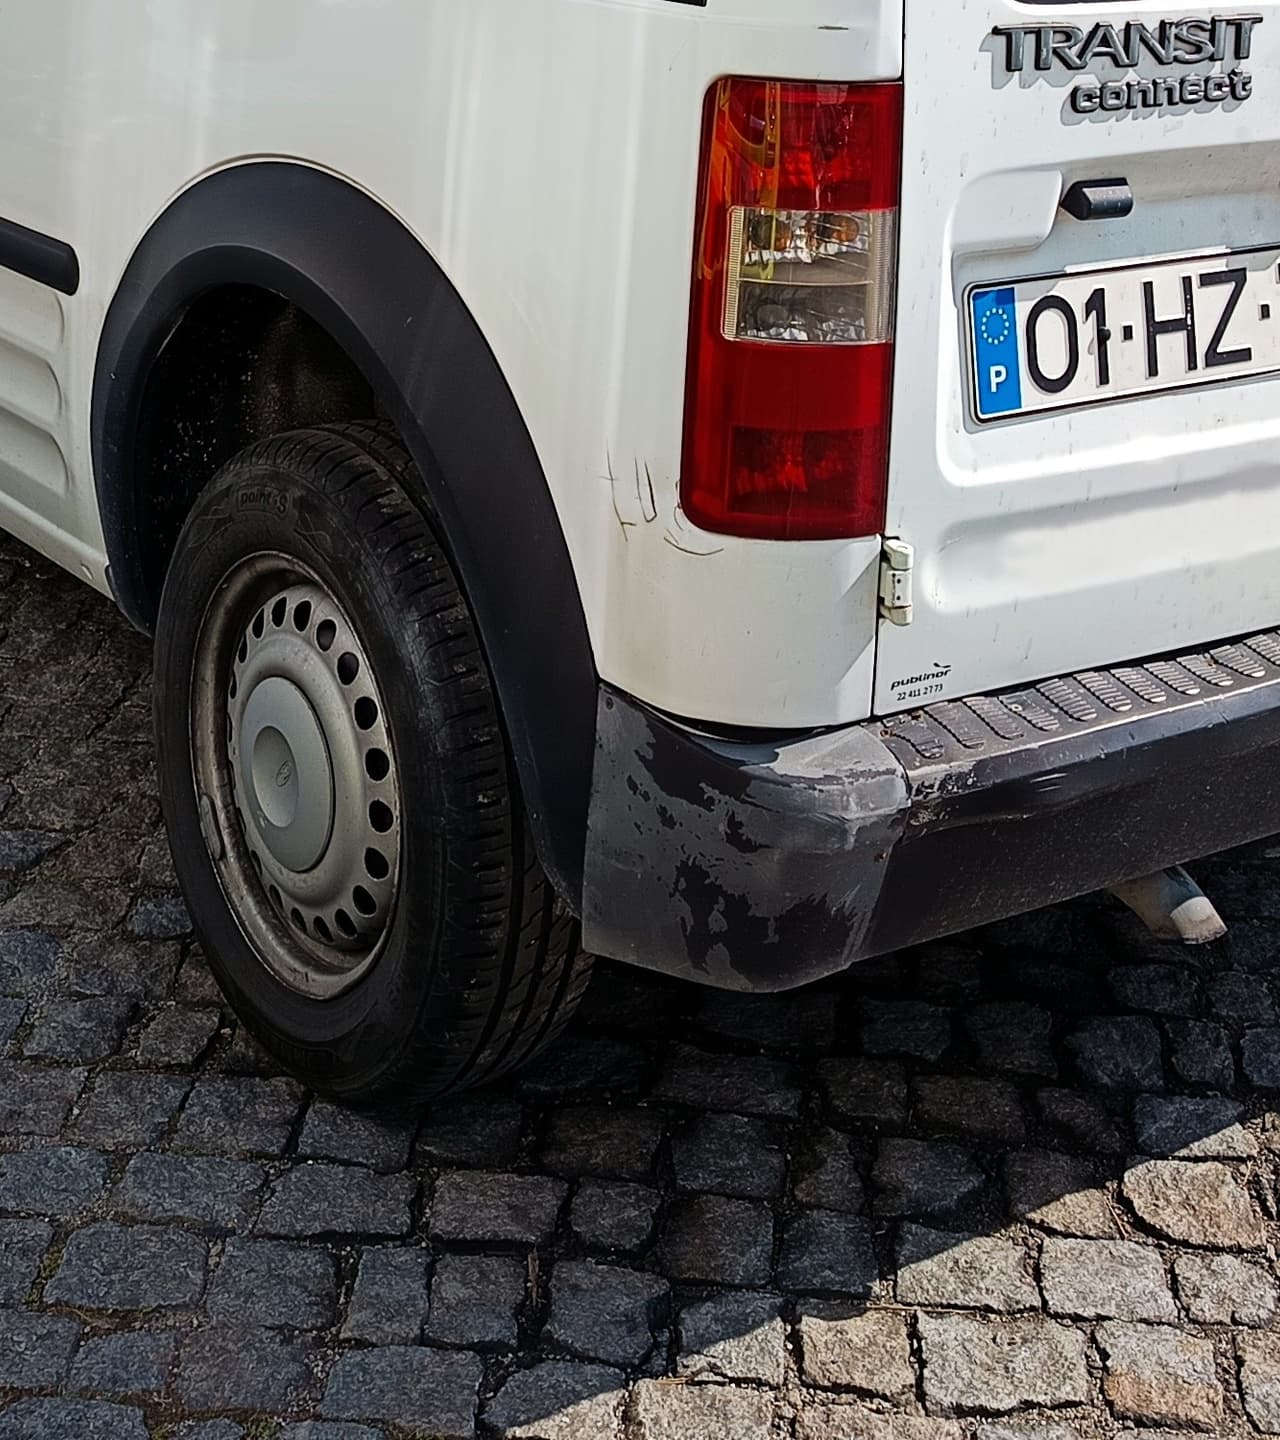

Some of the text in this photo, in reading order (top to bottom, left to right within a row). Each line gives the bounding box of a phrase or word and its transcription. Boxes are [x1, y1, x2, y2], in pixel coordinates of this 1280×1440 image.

[991, 13, 1264, 73] TRANSIT
[1070, 69, 1253, 114] connect
[988, 366, 1009, 393] P
[890, 668, 952, 691] publinor
